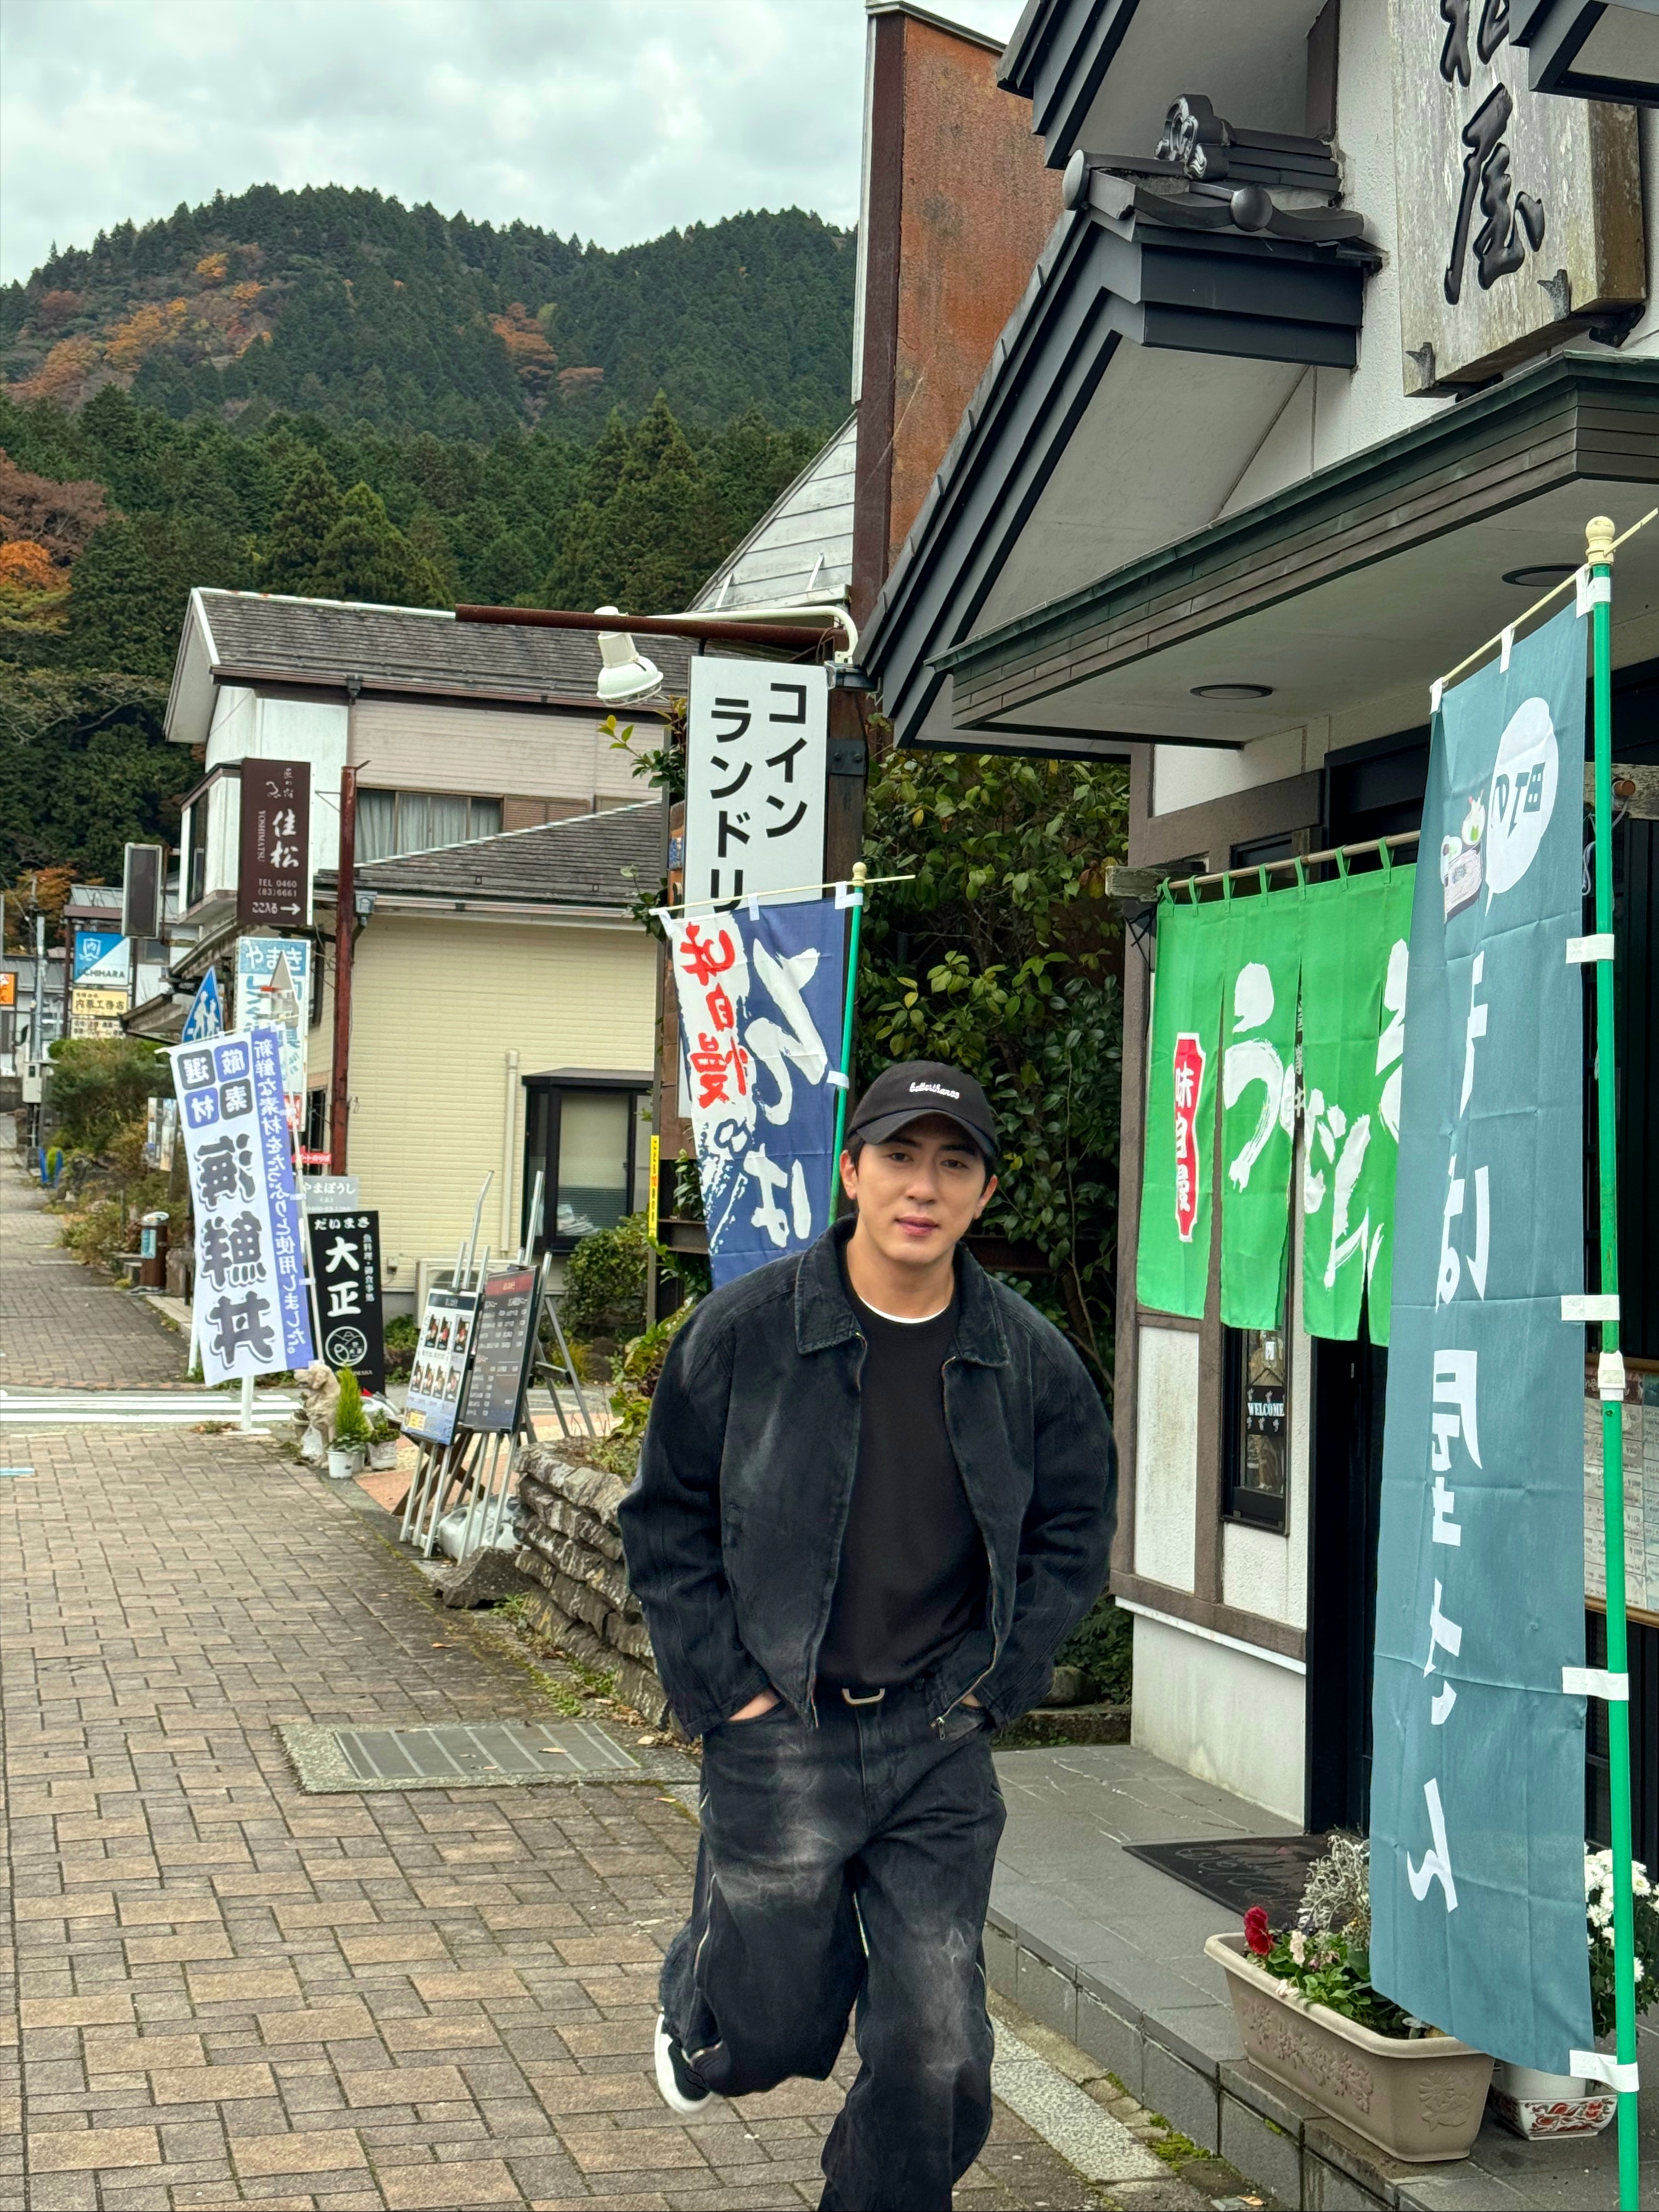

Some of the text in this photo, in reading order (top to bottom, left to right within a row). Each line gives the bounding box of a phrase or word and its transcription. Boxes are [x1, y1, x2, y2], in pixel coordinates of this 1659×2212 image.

[766, 683, 808, 838] コイン
[256, 810, 266, 863] YOSHIMATSU
[269, 808, 300, 868] 佳松
[258, 878, 297, 888] TEL 0460
[258, 888, 297, 898] (83)6661
[314, 1216, 370, 1231] だいまさ
[325, 1235, 362, 1317] 大正
[1247, 1402, 1285, 1417] WELCOME
